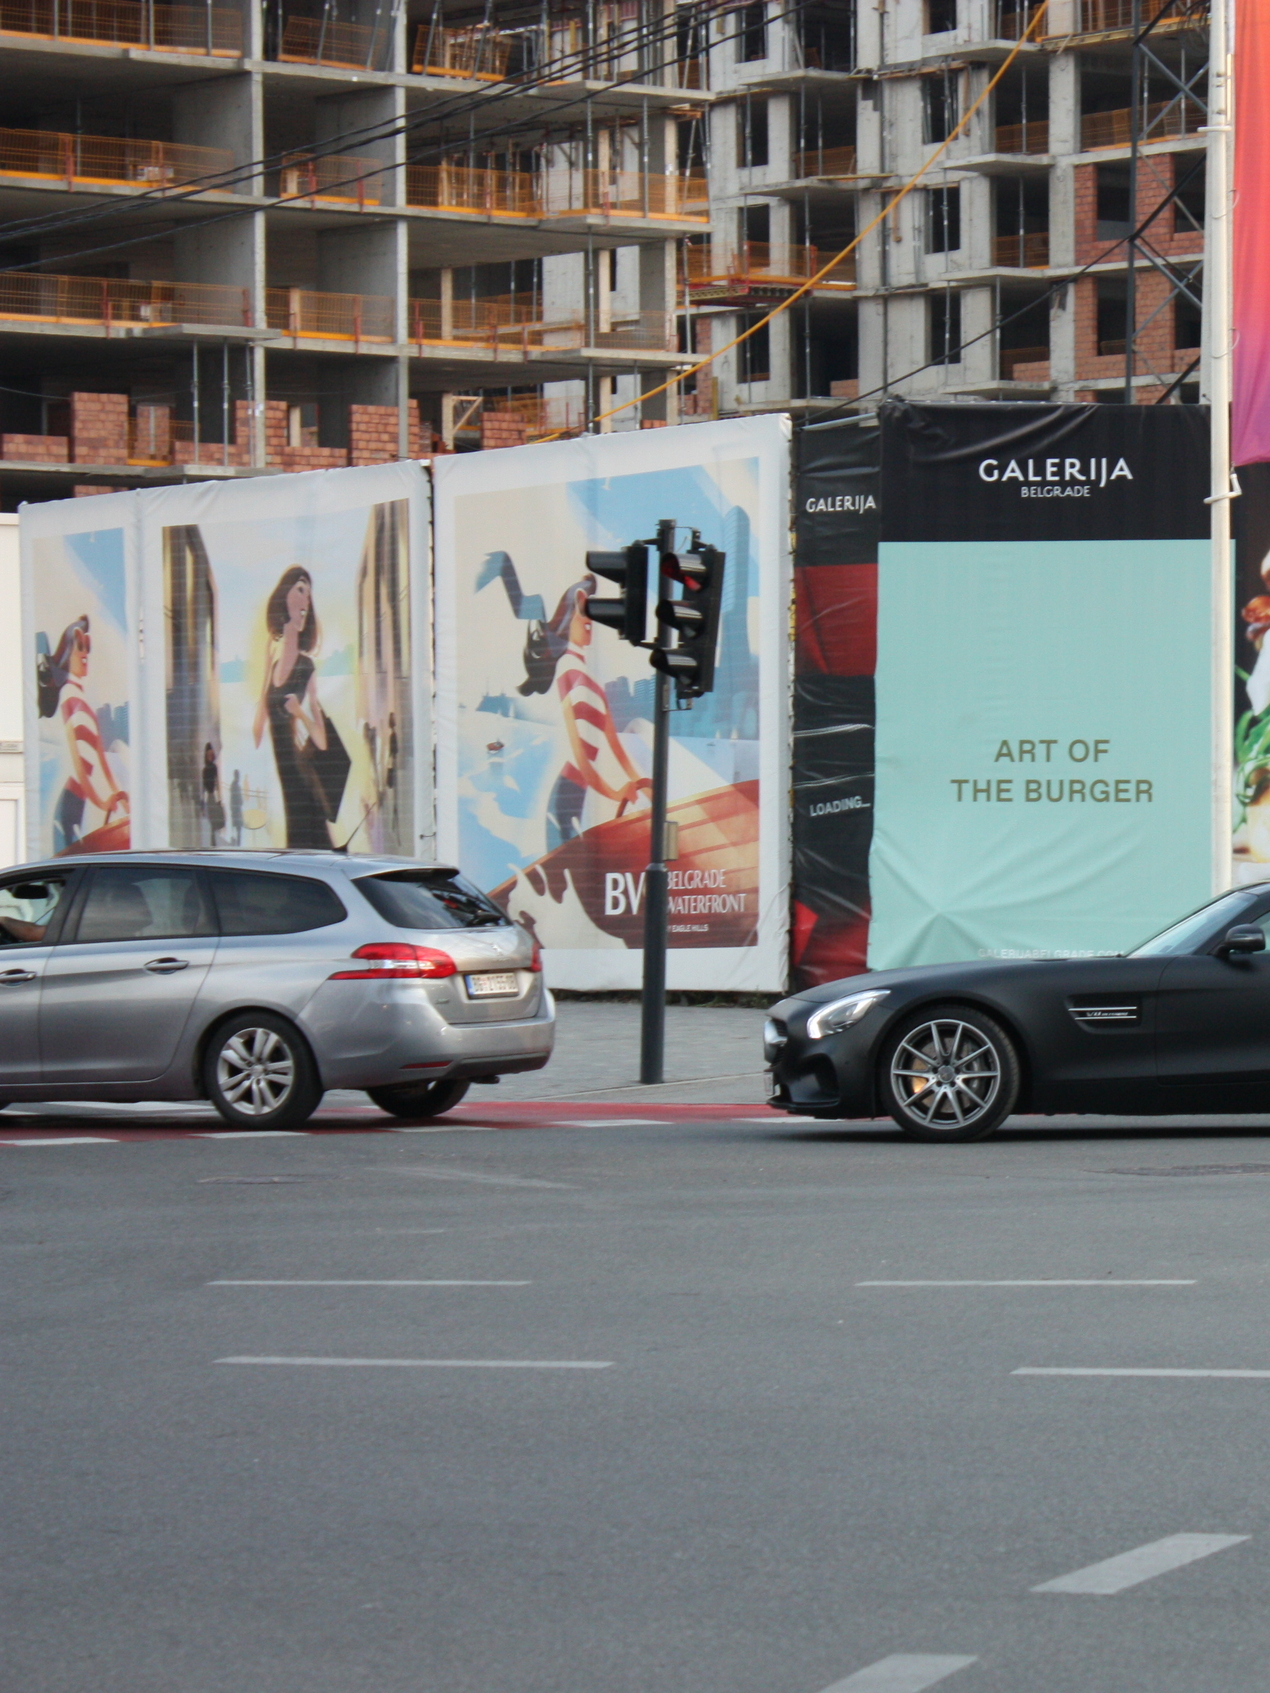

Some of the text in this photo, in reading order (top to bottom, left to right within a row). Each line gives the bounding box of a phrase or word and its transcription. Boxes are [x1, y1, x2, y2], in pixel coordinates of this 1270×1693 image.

[979, 457, 1133, 488] GALERIJA
[1020, 485, 1091, 498] BELGRADE
[806, 494, 876, 514] GALERIJA
[994, 739, 1110, 763] ART OF
[950, 779, 1153, 803] THE BURGER
